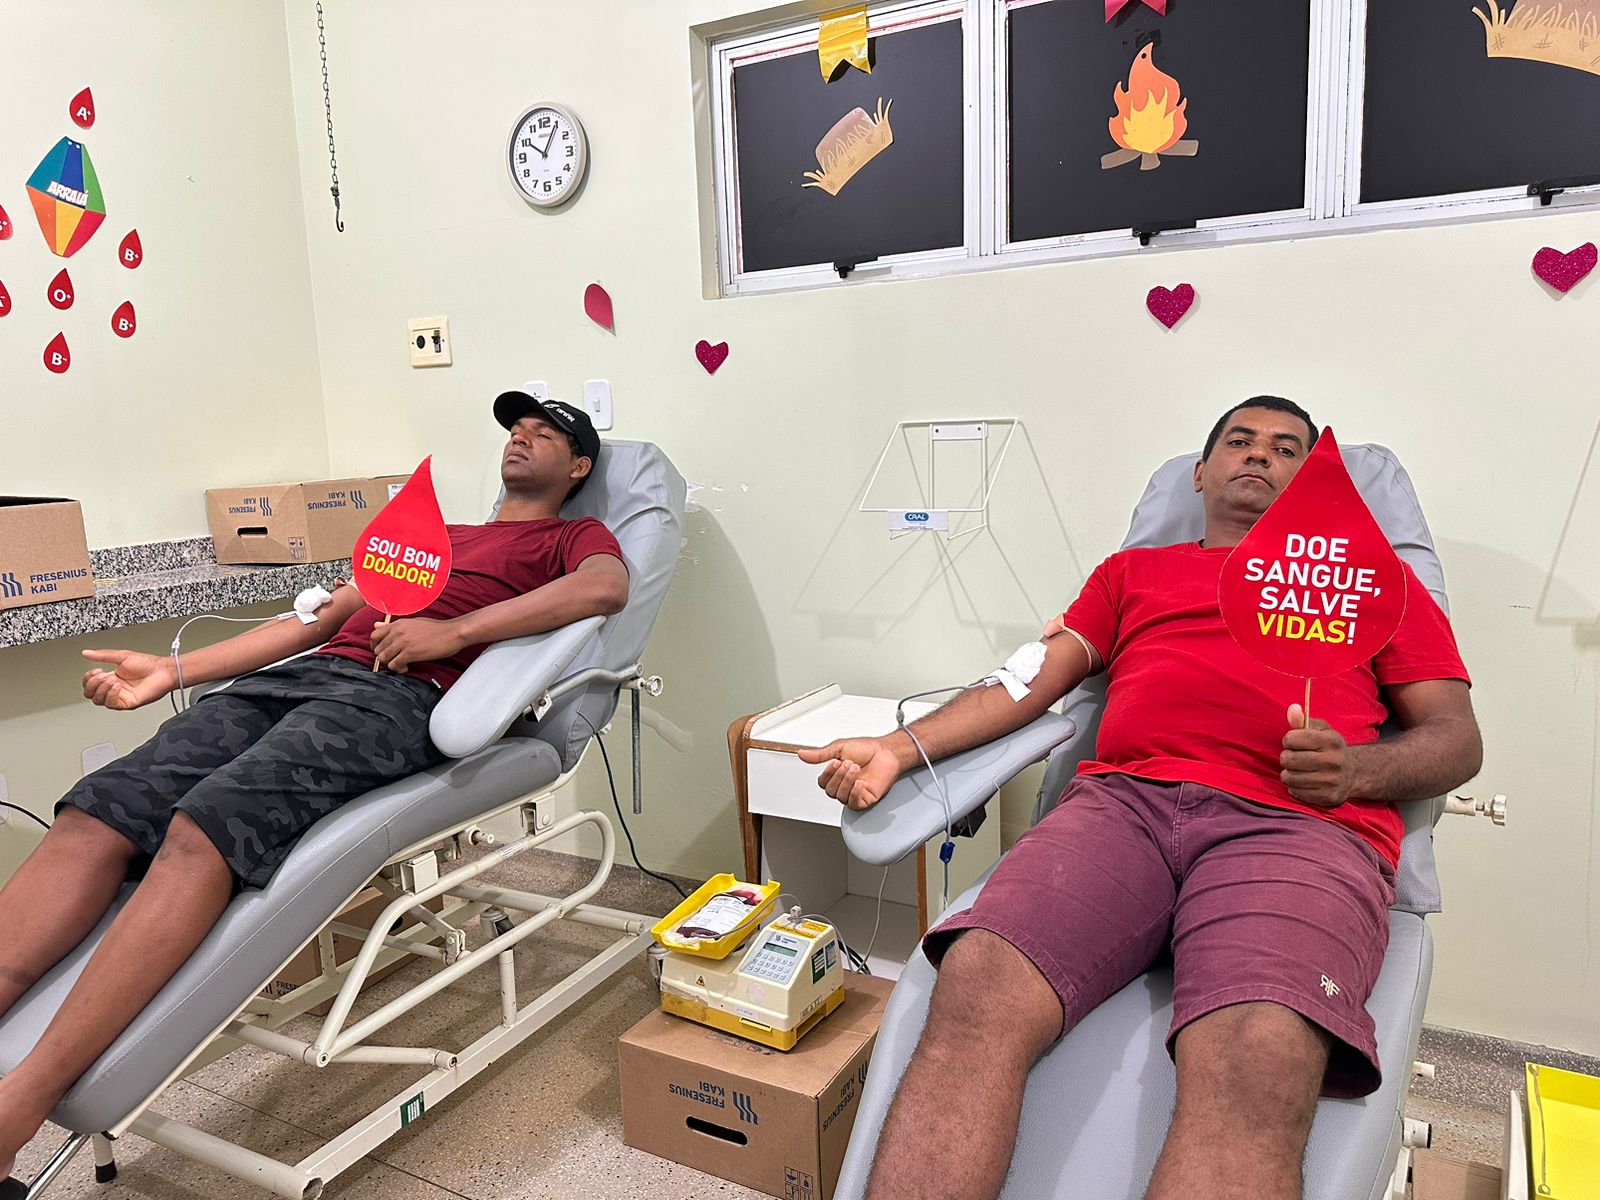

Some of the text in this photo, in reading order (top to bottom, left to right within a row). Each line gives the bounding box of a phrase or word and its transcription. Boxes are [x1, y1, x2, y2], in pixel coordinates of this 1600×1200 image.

[529, 124, 536, 133] 11
[538, 117, 551, 129] 12
[562, 131, 569, 140] 2
[521, 138, 531, 147] 10
[565, 146, 574, 157] 3
[519, 153, 527, 164] 9
[523, 169, 531, 178] 8
[563, 164, 571, 172] 4
[532, 179, 539, 188] 7
[555, 176, 563, 185] 5
[543, 181, 552, 192] 6
[47, 180, 89, 207] ARRAIÁ
[328, 491, 346, 500] KABI
[307, 500, 346, 510] FRESENIUS
[1285, 533, 1349, 563] DOE
[366, 536, 441, 572] SOU BOM
[30, 568, 88, 584] FRESENIUS
[362, 553, 436, 589] DOADOR!
[1244, 557, 1382, 598] SANGUE,
[31, 583, 57, 594] KABI
[1259, 586, 1361, 618] SALVE
[1257, 612, 1356, 645] VIDAS!
[699, 1081, 725, 1097] KABI
[668, 1083, 725, 1109] FRESENIUS
[823, 1088, 855, 1132] FRESENIUS
